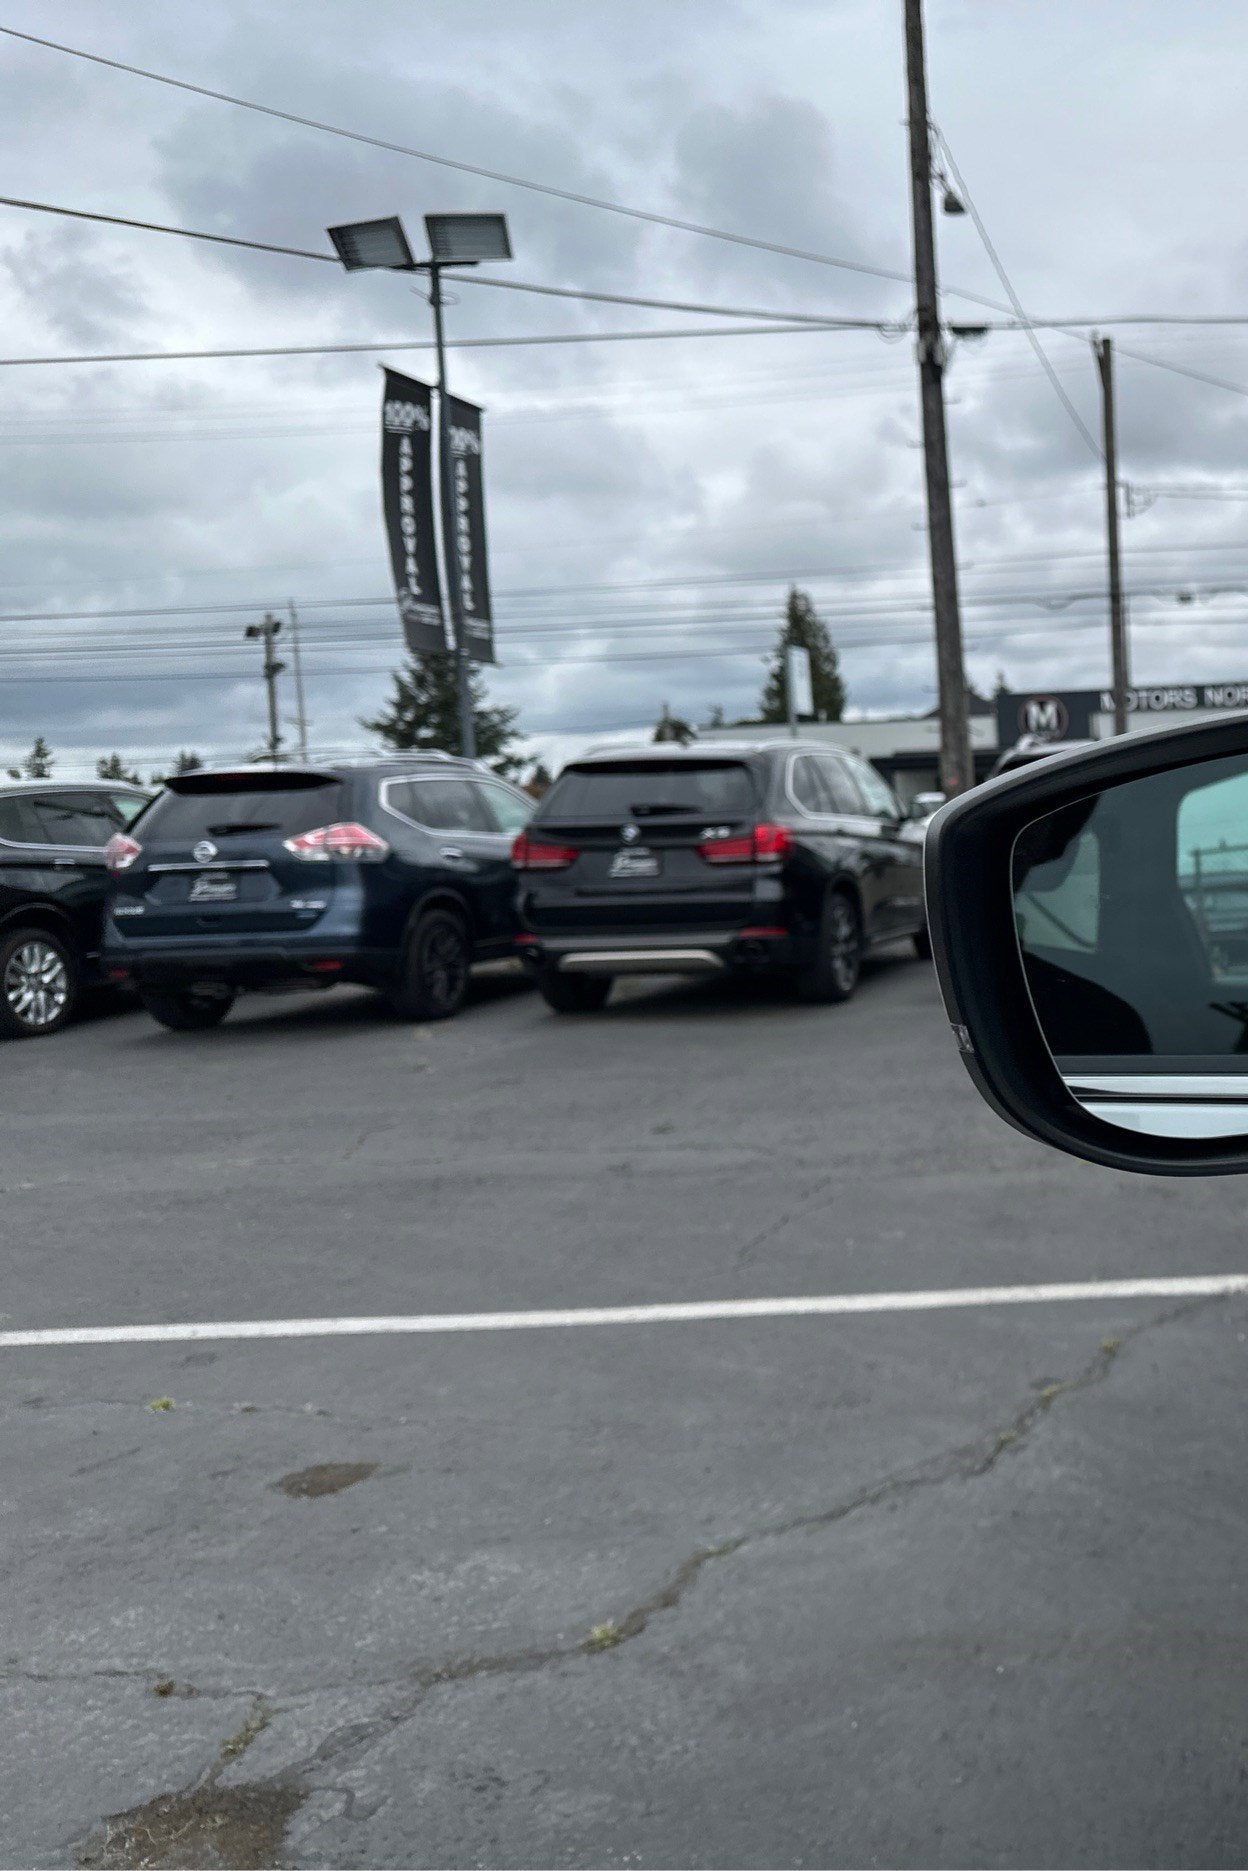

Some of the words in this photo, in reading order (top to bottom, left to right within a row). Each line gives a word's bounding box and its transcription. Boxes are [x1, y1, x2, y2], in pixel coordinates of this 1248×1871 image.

[384, 400, 430, 432] 100%
[399, 434, 422, 596] APPROVAL
[456, 459, 475, 611] APPROVAL
[1028, 701, 1057, 731] M
